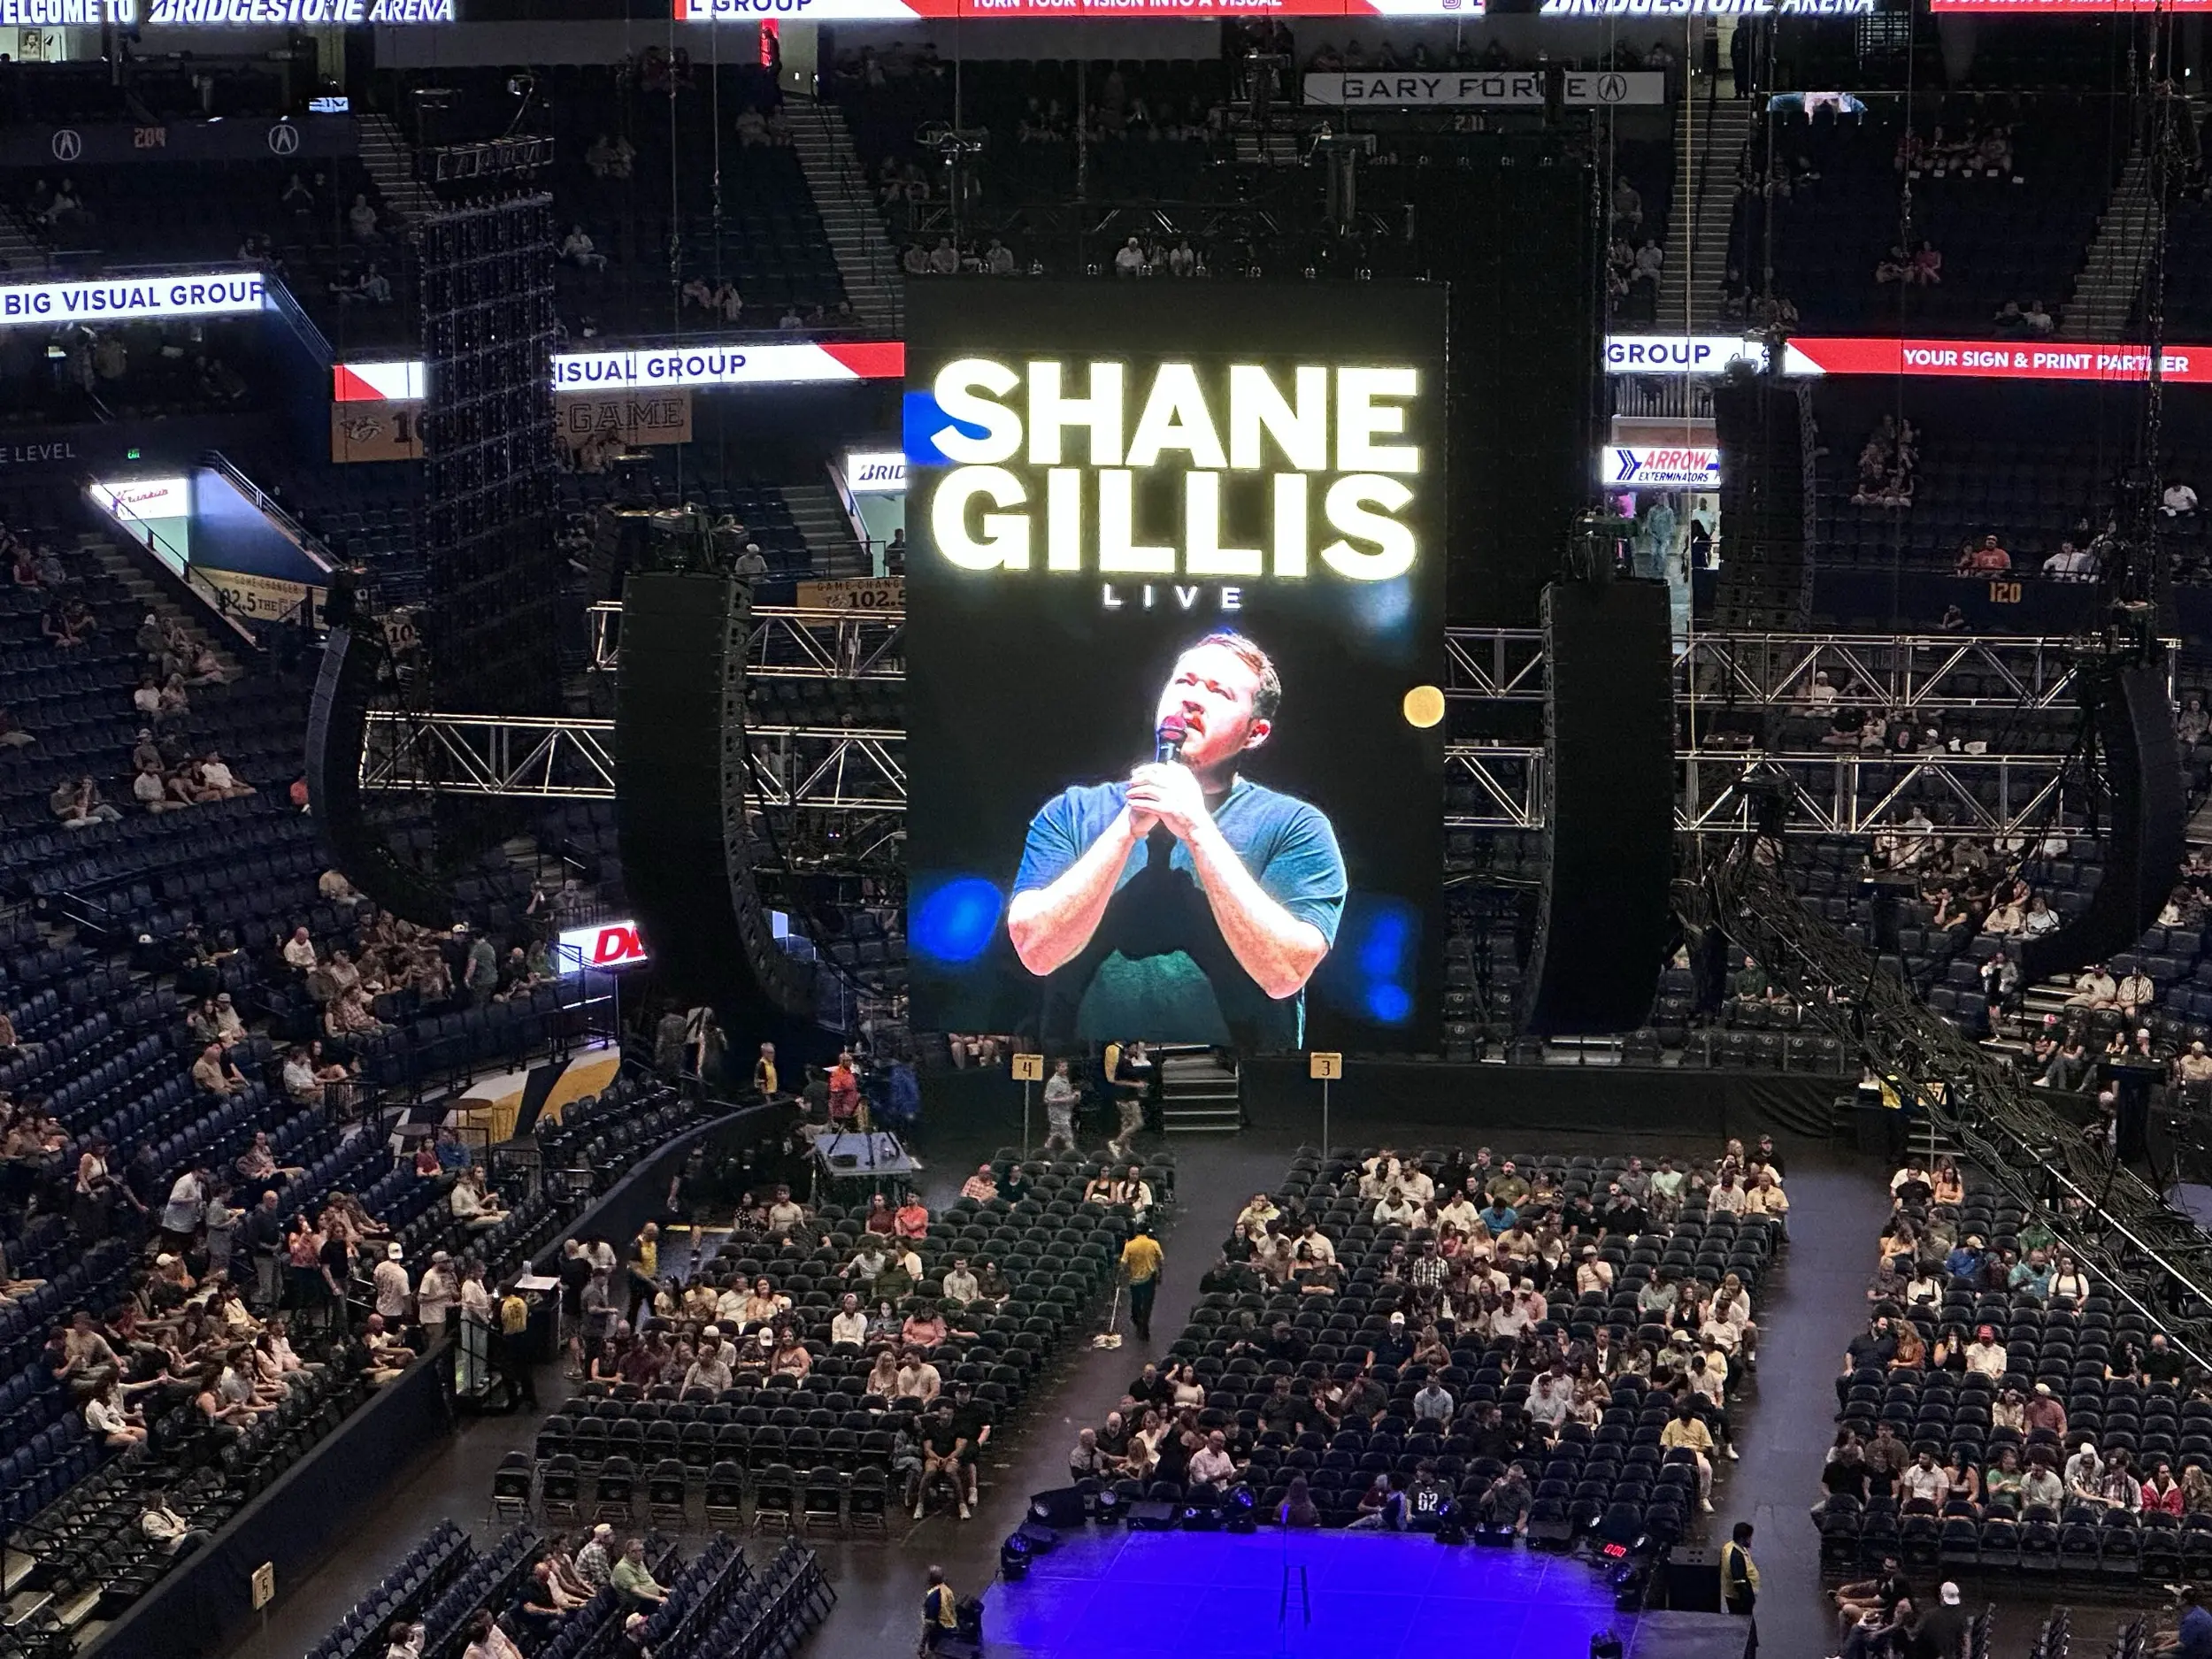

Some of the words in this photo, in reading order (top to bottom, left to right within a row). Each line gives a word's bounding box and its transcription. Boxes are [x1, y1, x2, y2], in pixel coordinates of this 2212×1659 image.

[0, 0, 100, 24] ELCOME
[106, 0, 135, 23] TO
[369, 0, 454, 22] ARENA
[1342, 79, 1441, 98] GARY
[1459, 79, 1586, 98] FORE
[134, 127, 166, 148] 204
[4, 292, 50, 315] BIG
[62, 287, 160, 311] VISUAL
[170, 281, 263, 305] GROUP
[1607, 343, 1711, 364] GROUP
[1903, 349, 1957, 367] YOUR
[1962, 350, 2010, 368] SIGN
[2015, 353, 2029, 369] &
[2032, 353, 2093, 370] PRINT
[556, 359, 637, 383] ISUAL
[647, 355, 746, 378] GROUP
[568, 399, 684, 434] GAME
[930, 357, 1420, 472] SHANE
[15, 442, 77, 462] LEVEL
[1643, 449, 1713, 471] ARROW
[1638, 472, 1709, 483] EXTERMINATORS
[931, 465, 1417, 580] GILLIS
[1102, 583, 1244, 610] LIVE
[1989, 581, 2022, 603] 120
[1022, 1061, 1033, 1078] 4
[1321, 1060, 1331, 1077] 3
[1417, 1492, 1439, 1512] 62
